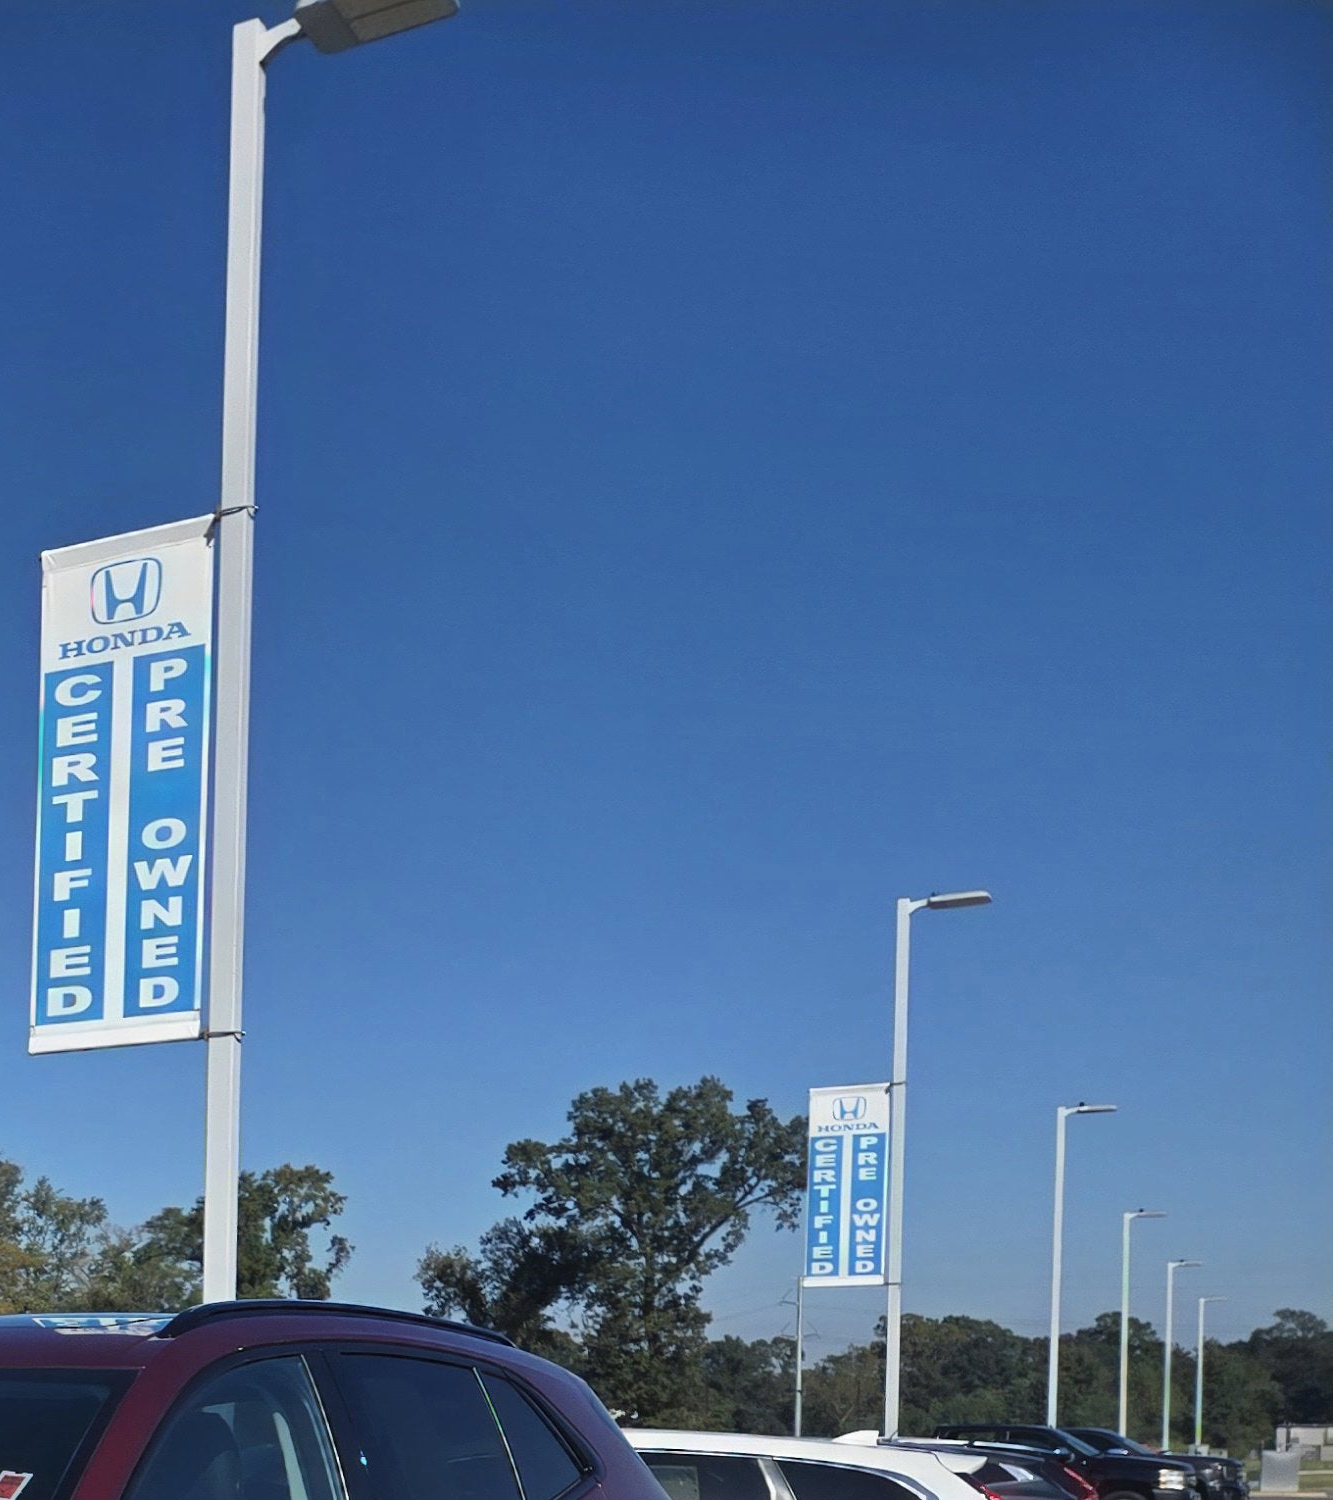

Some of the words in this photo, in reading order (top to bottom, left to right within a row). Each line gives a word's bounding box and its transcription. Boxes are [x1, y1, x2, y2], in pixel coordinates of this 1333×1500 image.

[58, 621, 191, 660] HONDA
[145, 657, 189, 772] PRE
[45, 673, 102, 1017] CERTIFIED
[134, 817, 193, 1009] OWNED
[817, 1121, 880, 1133] HONDA
[857, 1136, 878, 1181] PRE
[810, 1138, 838, 1275] CERTIFIED
[852, 1198, 880, 1274] OWNED
